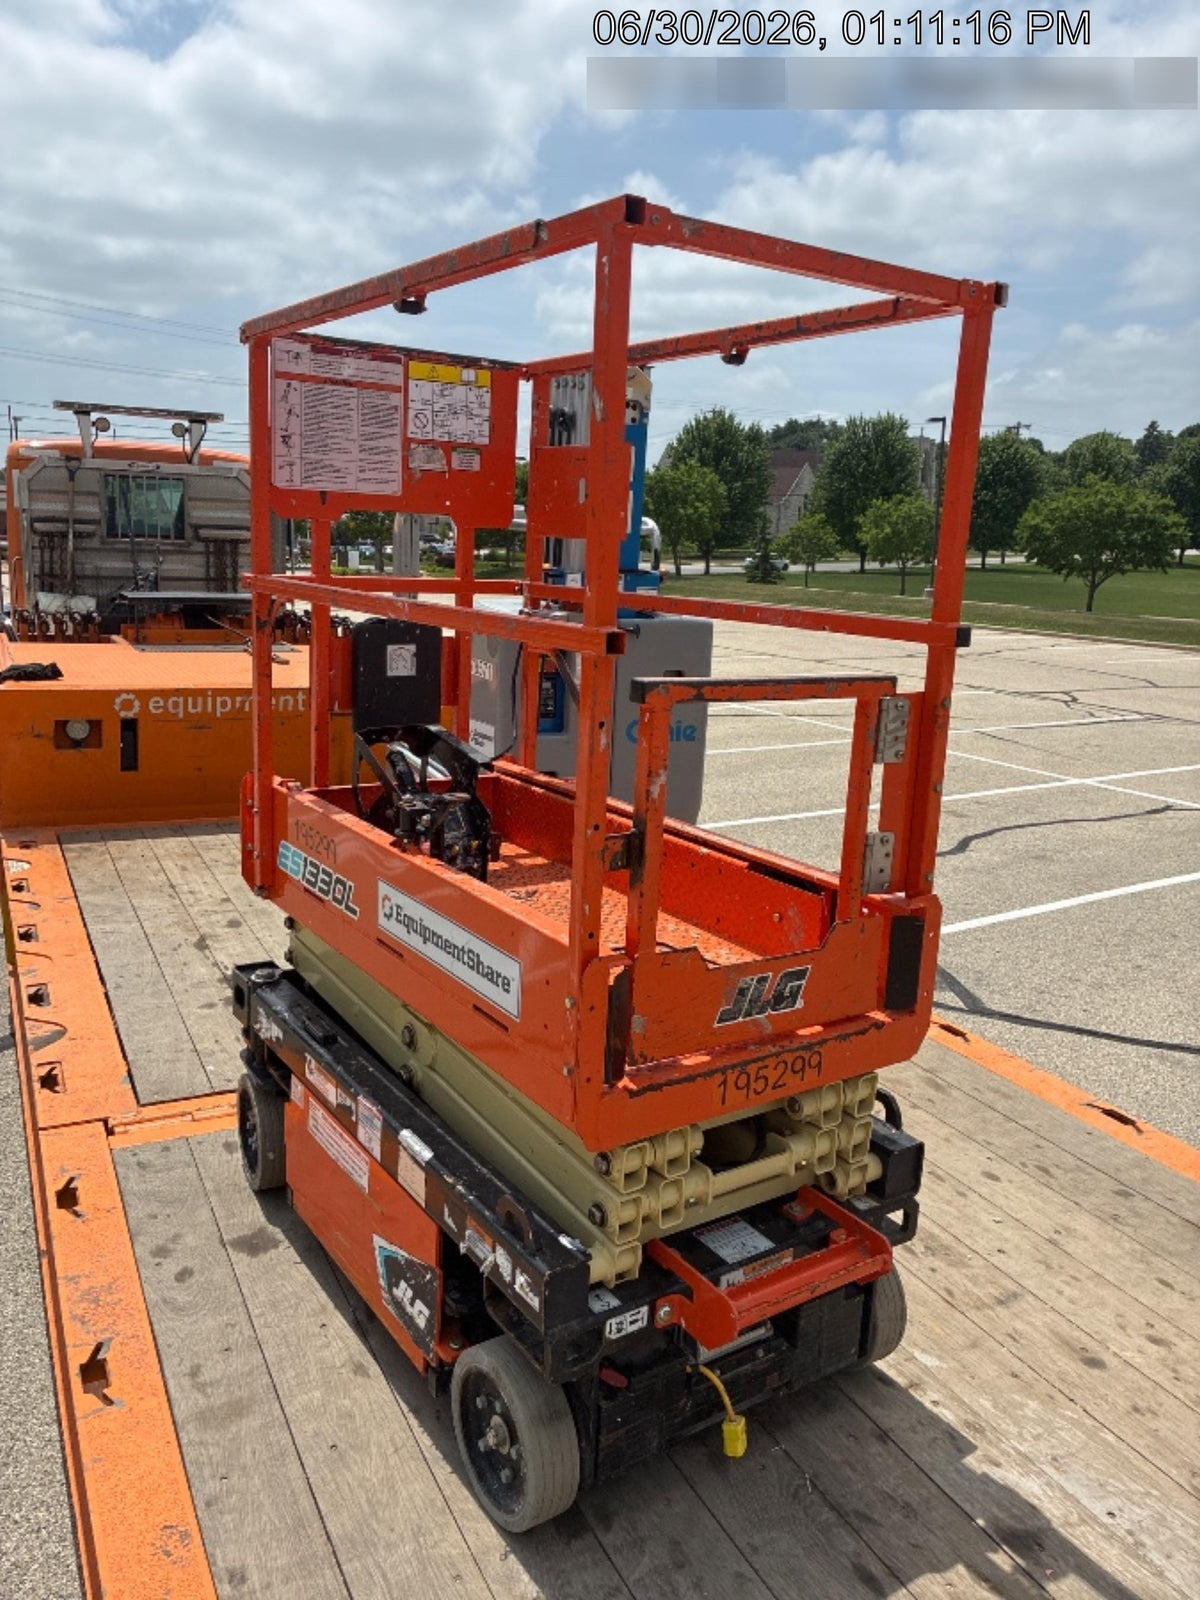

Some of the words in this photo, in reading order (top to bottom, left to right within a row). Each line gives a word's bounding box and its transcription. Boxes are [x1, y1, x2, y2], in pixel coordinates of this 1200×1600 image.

[148, 690, 306, 718] equipmnt
[278, 840, 360, 920] ES1330L
[394, 903, 513, 994] EquipmentShare
[713, 965, 812, 1028] JLG
[717, 1050, 823, 1107] 195299
[392, 1279, 430, 1330] JLG
